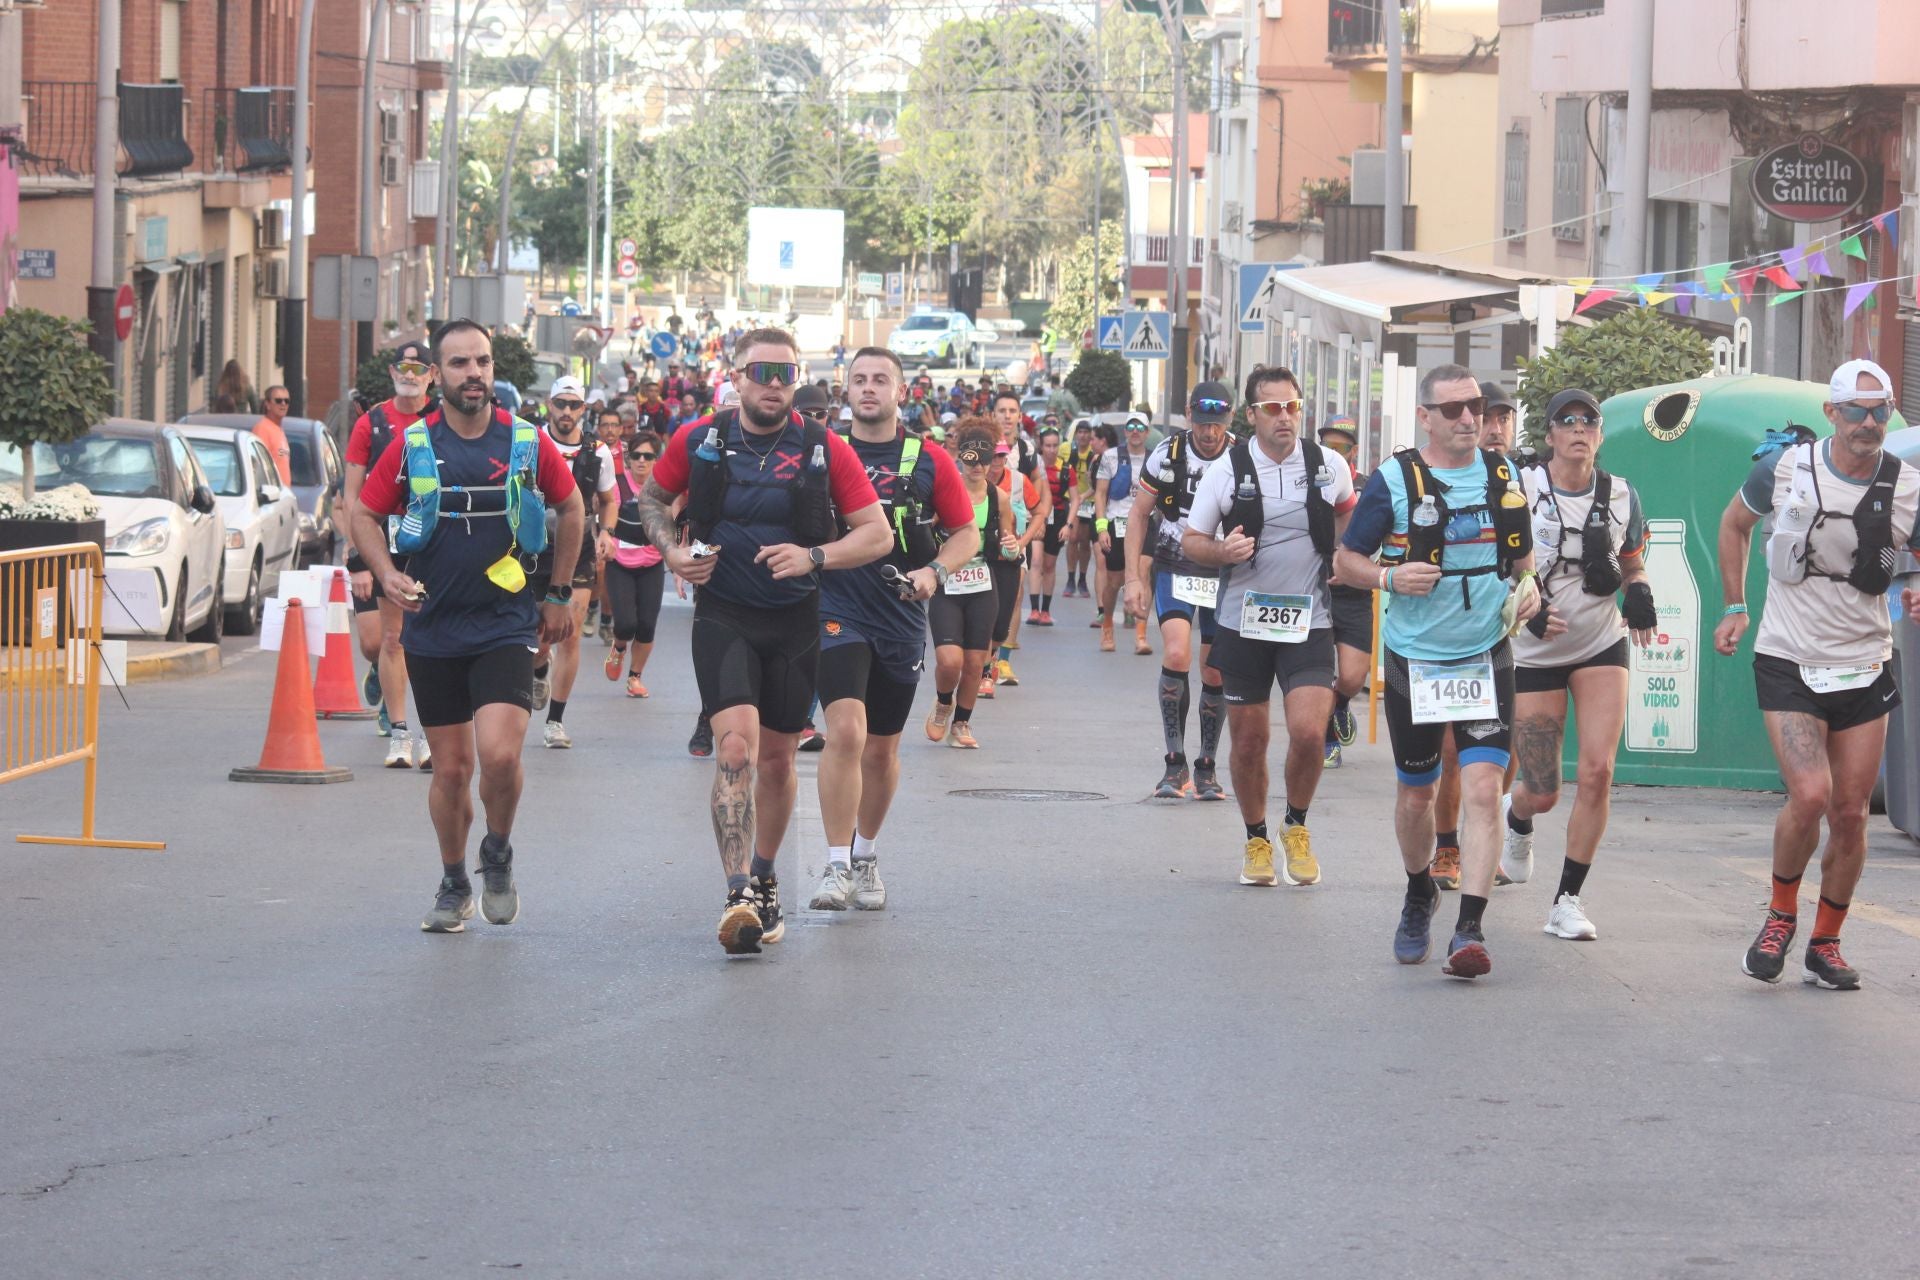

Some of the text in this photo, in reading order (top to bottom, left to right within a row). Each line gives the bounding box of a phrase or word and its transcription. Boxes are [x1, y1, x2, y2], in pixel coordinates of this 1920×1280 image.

[1769, 158, 1852, 181] Estrella
[1772, 180, 1847, 203] Galicia
[1646, 420, 1688, 441] DE VIDRIO
[955, 567, 984, 583] 5216
[1186, 577, 1216, 594] 3383
[1258, 606, 1302, 626] 2367
[1431, 679, 1482, 701] 1460
[1647, 677, 1676, 692] SOLO
[1643, 693, 1680, 709] VIDRIO
[1163, 701, 1178, 738] SOCKS
